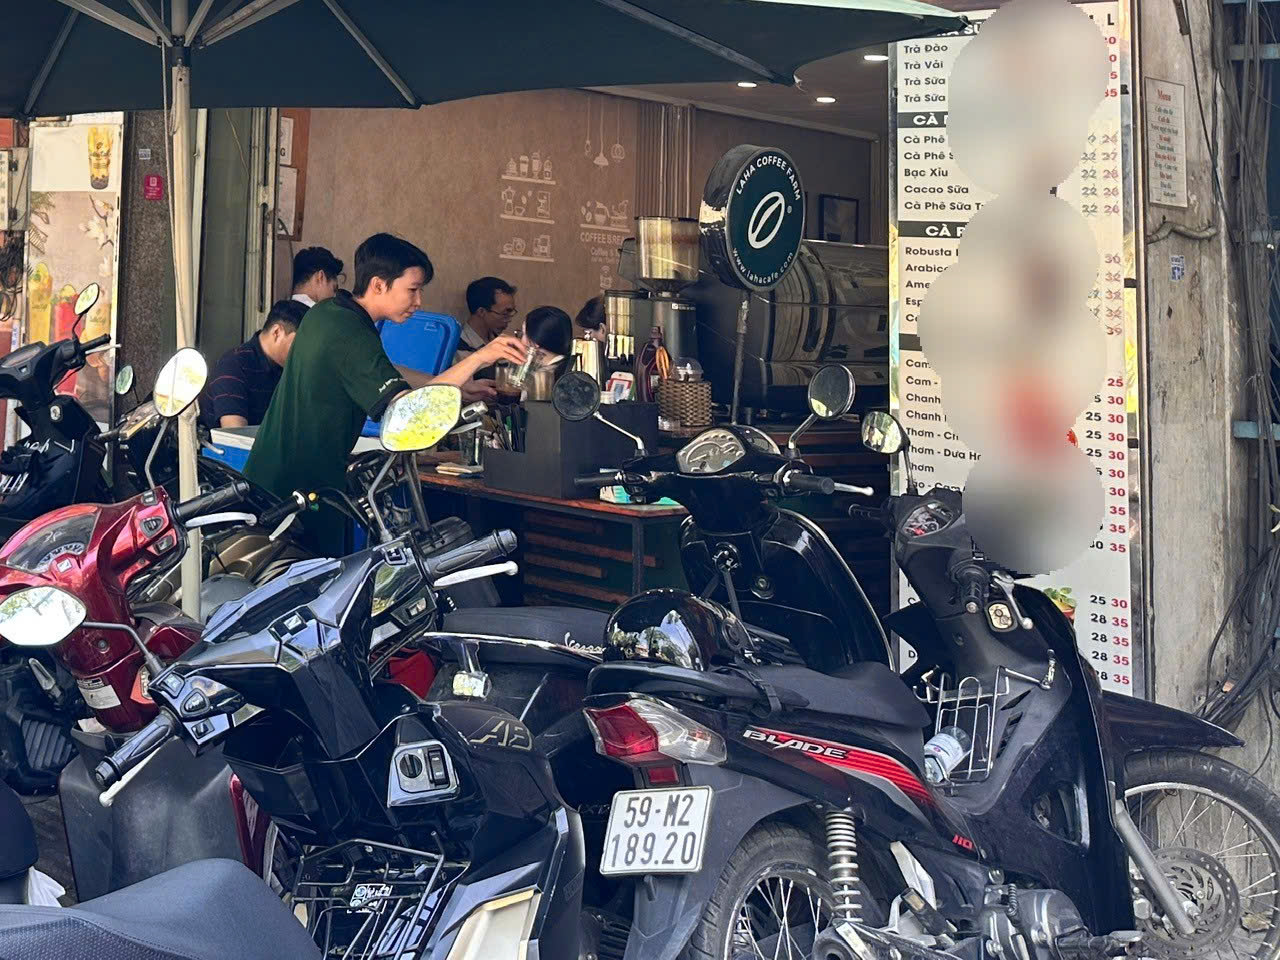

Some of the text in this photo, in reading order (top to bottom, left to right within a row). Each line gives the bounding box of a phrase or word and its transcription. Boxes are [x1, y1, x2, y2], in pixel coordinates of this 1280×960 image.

[1107, 13, 1114, 26] L
[904, 45, 920, 54] Trà
[924, 43, 948, 52] Đào
[904, 61, 920, 69] Trà
[904, 77, 920, 86] Trà
[924, 76, 946, 85] Sữa
[904, 93, 920, 103] Trà
[924, 92, 946, 102] Sữa
[913, 113, 939, 126] CÀ
[903, 134, 945, 144] Cà Phê
[903, 151, 920, 160] Cà
[924, 151, 945, 160] Phê
[736, 156, 801, 201] LAHA COFFEE FARM
[904, 168, 926, 179] Bạc
[904, 185, 944, 194] Cacao
[947, 184, 969, 194] Sữa
[904, 201, 921, 210] Cà
[924, 201, 946, 210] Phê
[949, 201, 972, 211] Sữa
[925, 223, 952, 237] CÀ
[905, 247, 952, 256] Robusta
[906, 375, 932, 386] Cam
[1107, 378, 1124, 387] 25
[906, 393, 941, 404] Chanh
[1107, 396, 1124, 405] 30
[906, 410, 1124, 424] Chanh 25 30
[906, 427, 934, 438] Thơm
[1086, 430, 1102, 439] 25
[1108, 432, 1125, 442] 30
[910, 445, 934, 455] hơm
[943, 448, 966, 459] Dưa
[1086, 448, 1102, 457] 25
[1108, 450, 1125, 461] 30
[911, 463, 934, 473] hơm
[1108, 469, 1125, 479] 30
[1109, 487, 1126, 497] 30
[1109, 505, 1126, 516] 35
[1109, 523, 1126, 534] 35
[1109, 543, 1127, 553] 35
[1090, 594, 1128, 609] 25 30
[1090, 613, 1129, 628] 28 35
[1091, 632, 1130, 647] 28 35
[1091, 650, 1130, 666] 28 35
[1113, 674, 1130, 685] 35
[742, 729, 849, 759] BLADE
[610, 830, 698, 867] 189.20
